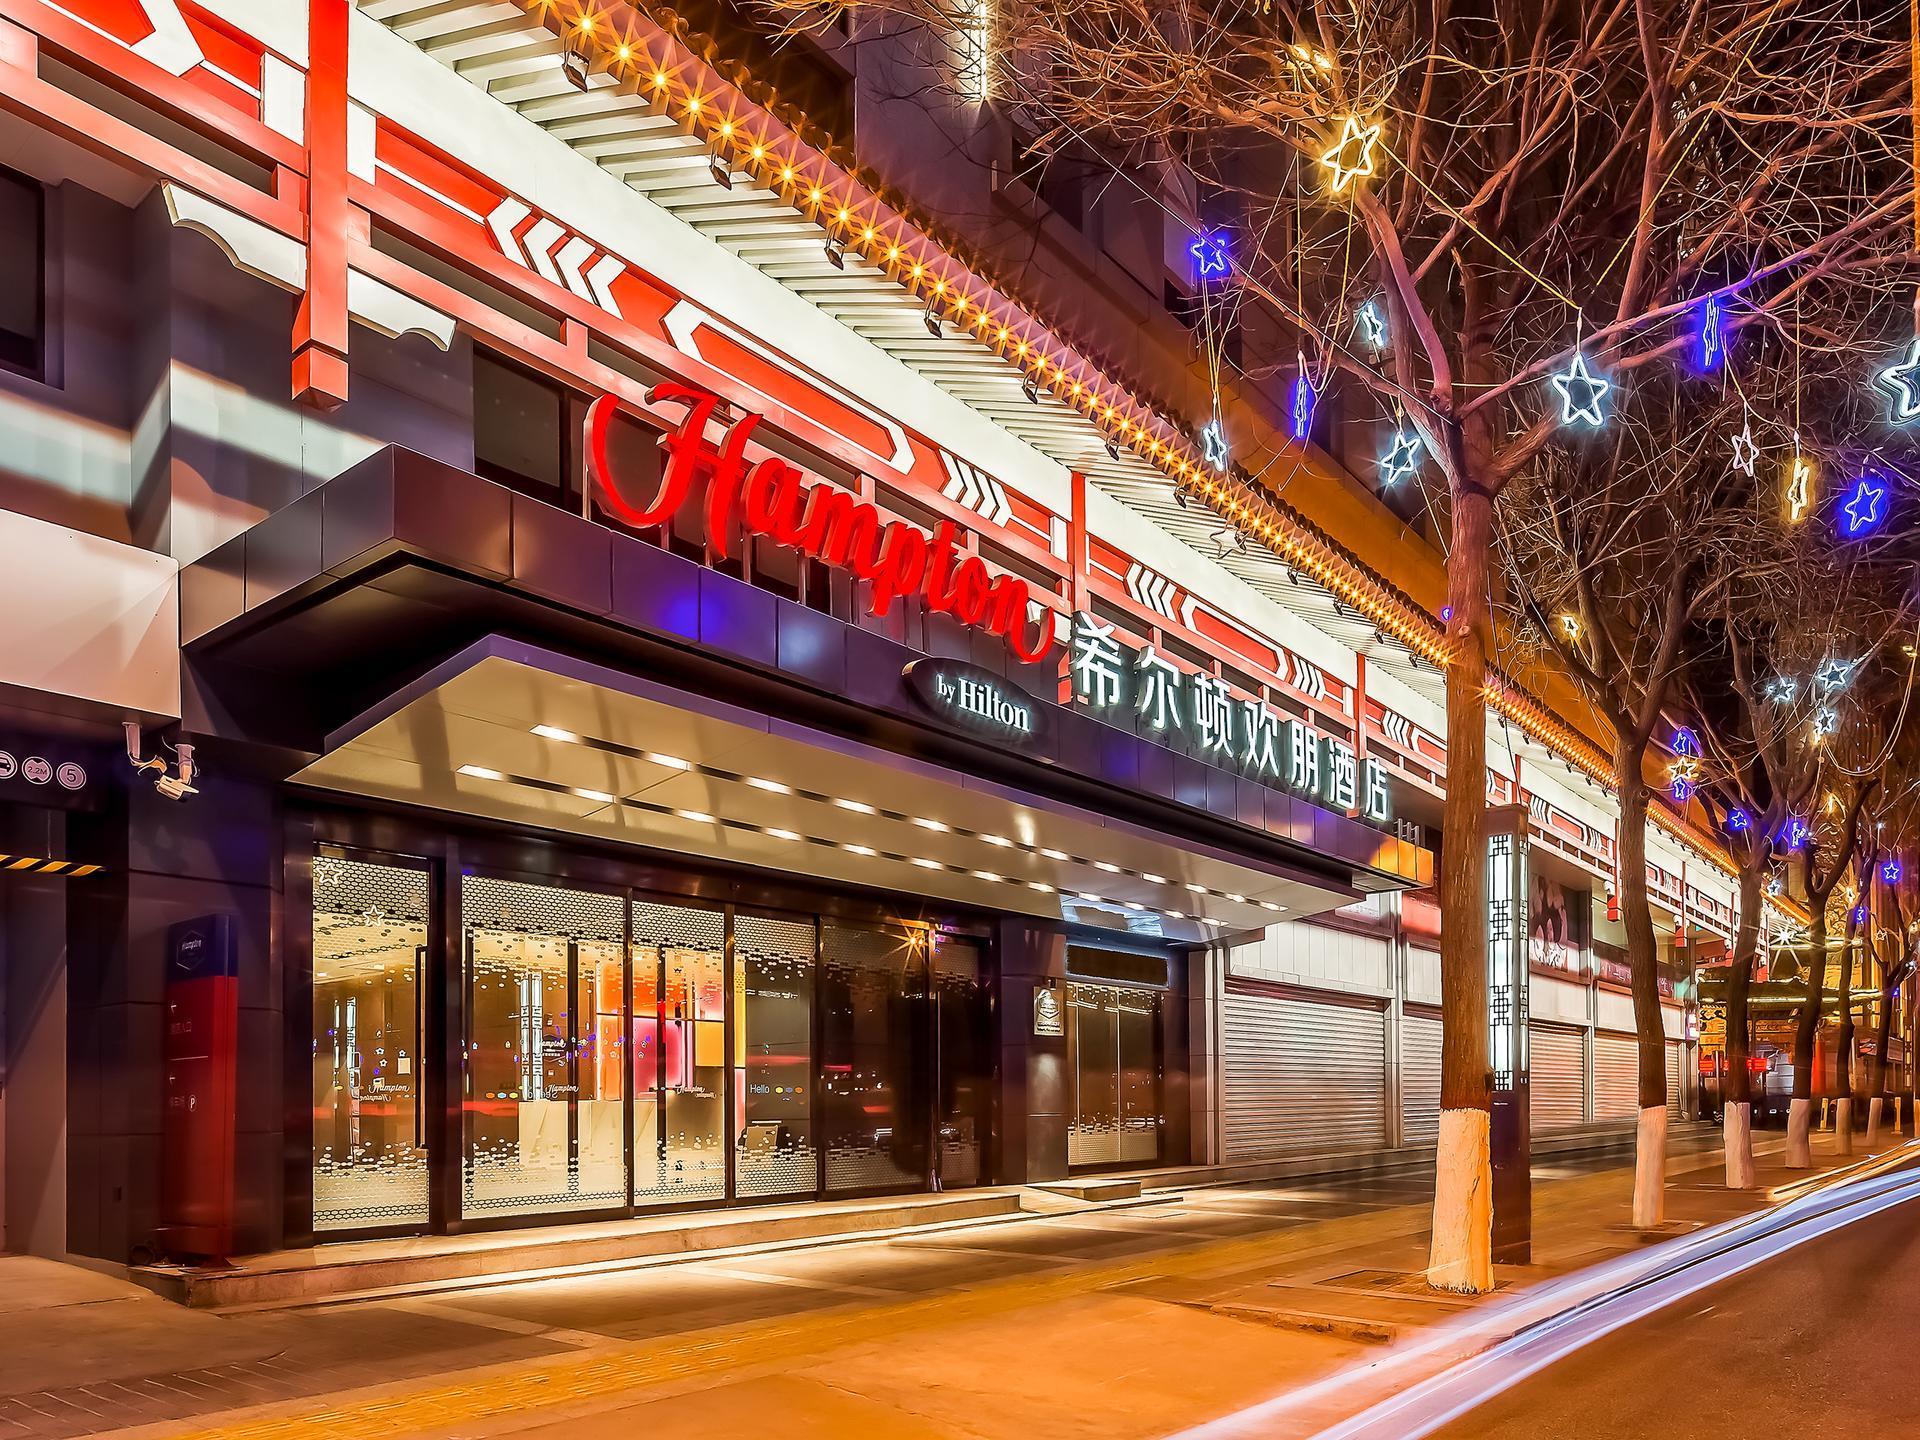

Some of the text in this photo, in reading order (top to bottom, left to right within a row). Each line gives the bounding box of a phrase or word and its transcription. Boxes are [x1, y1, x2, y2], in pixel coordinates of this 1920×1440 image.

[583, 382, 1056, 664] Hampton
[935, 673, 1031, 732] by Hilton
[1073, 610, 1390, 822] 希尔顿欢朋酒店
[27, 766, 48, 775] 2.2M
[66, 768, 77, 783] 5
[750, 1084, 770, 1094] Hello
